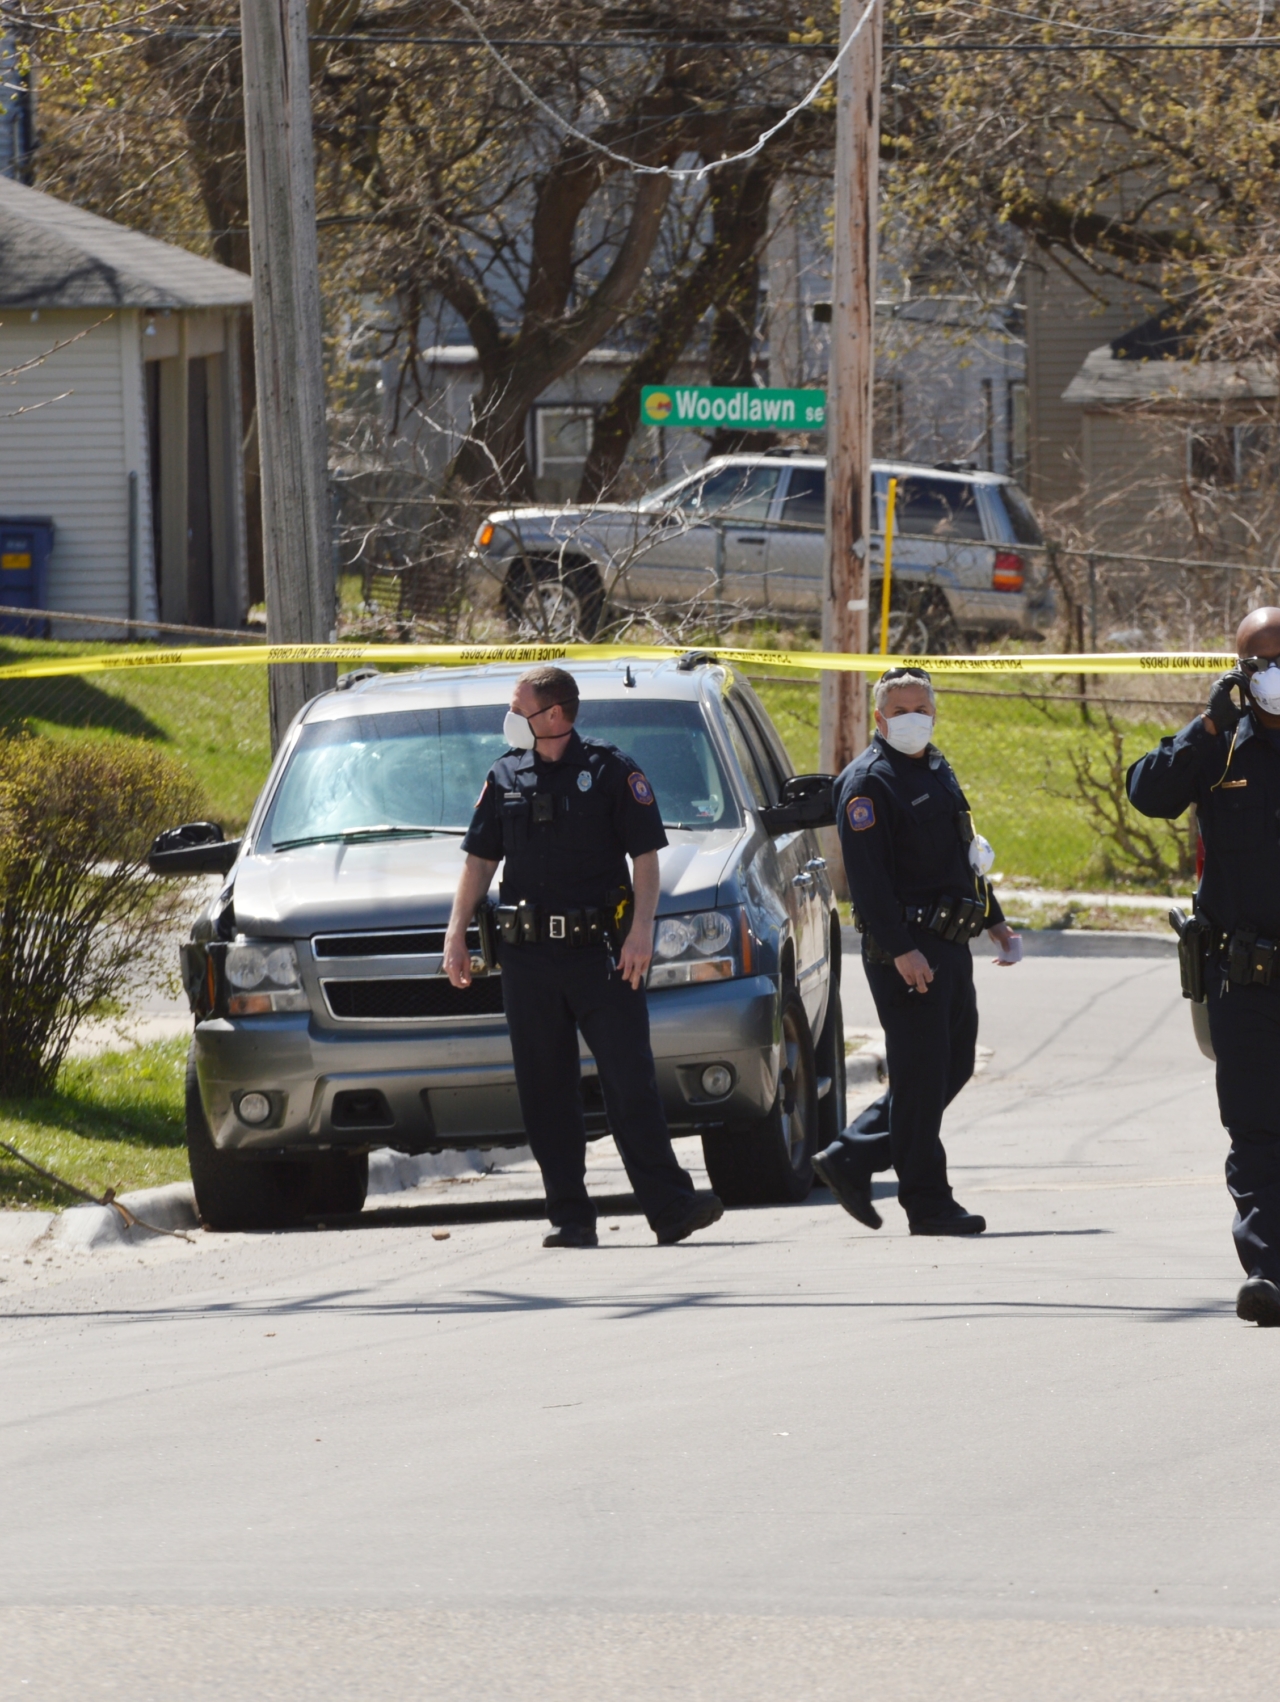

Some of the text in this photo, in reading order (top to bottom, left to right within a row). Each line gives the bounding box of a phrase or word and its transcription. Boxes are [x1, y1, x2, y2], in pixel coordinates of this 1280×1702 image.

[675, 390, 795, 422] Woodlawn
[268, 648, 293, 660] CROSS
[292, 647, 309, 659] NOT
[309, 648, 321, 659] DO
[321, 648, 340, 659] LINE
[460, 648, 566, 661] POLICE LINE DO NOT CROSS
[902, 659, 1023, 669] POLICE LINE DO NOT CROSS
[1140, 656, 1169, 669] CROSS
[1172, 657, 1190, 669] NOT
[1192, 657, 1205, 669] DO
[1207, 656, 1228, 669] LINE
